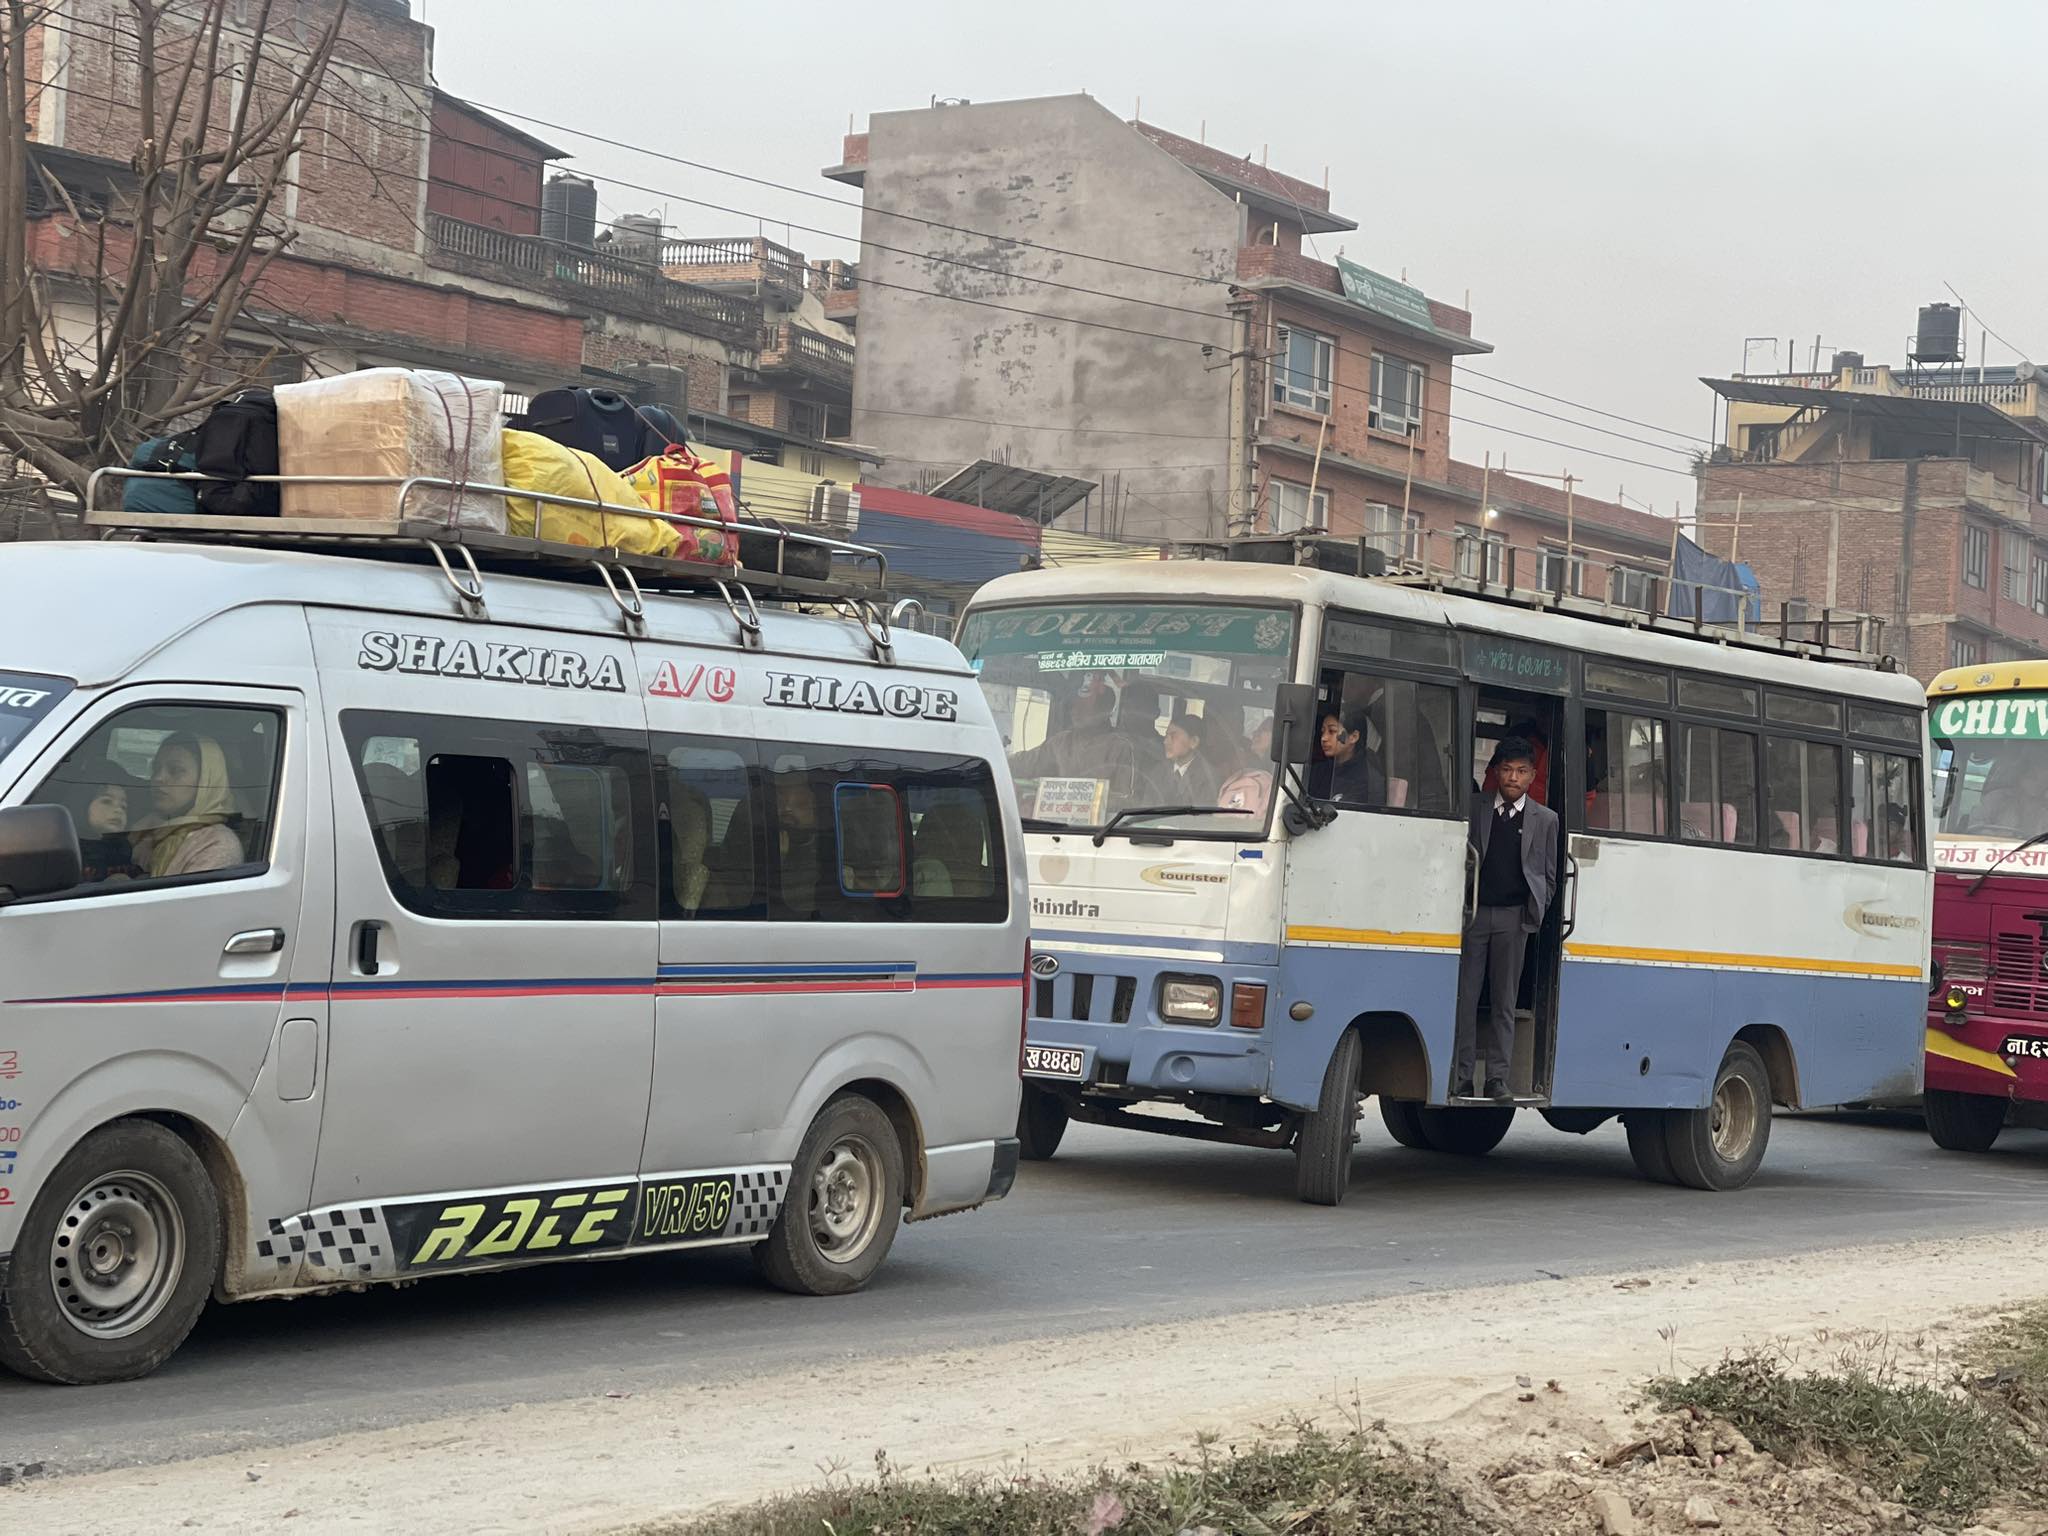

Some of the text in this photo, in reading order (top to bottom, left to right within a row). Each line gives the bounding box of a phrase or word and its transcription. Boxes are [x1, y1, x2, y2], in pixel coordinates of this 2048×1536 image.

[995, 613, 1251, 638] TOURIST
[358, 631, 958, 722] SHAKIRA A/C HIACE
[1160, 871, 1228, 884] tourister
[1030, 897, 1100, 918] hindra
[643, 1180, 733, 1237] VR/56
